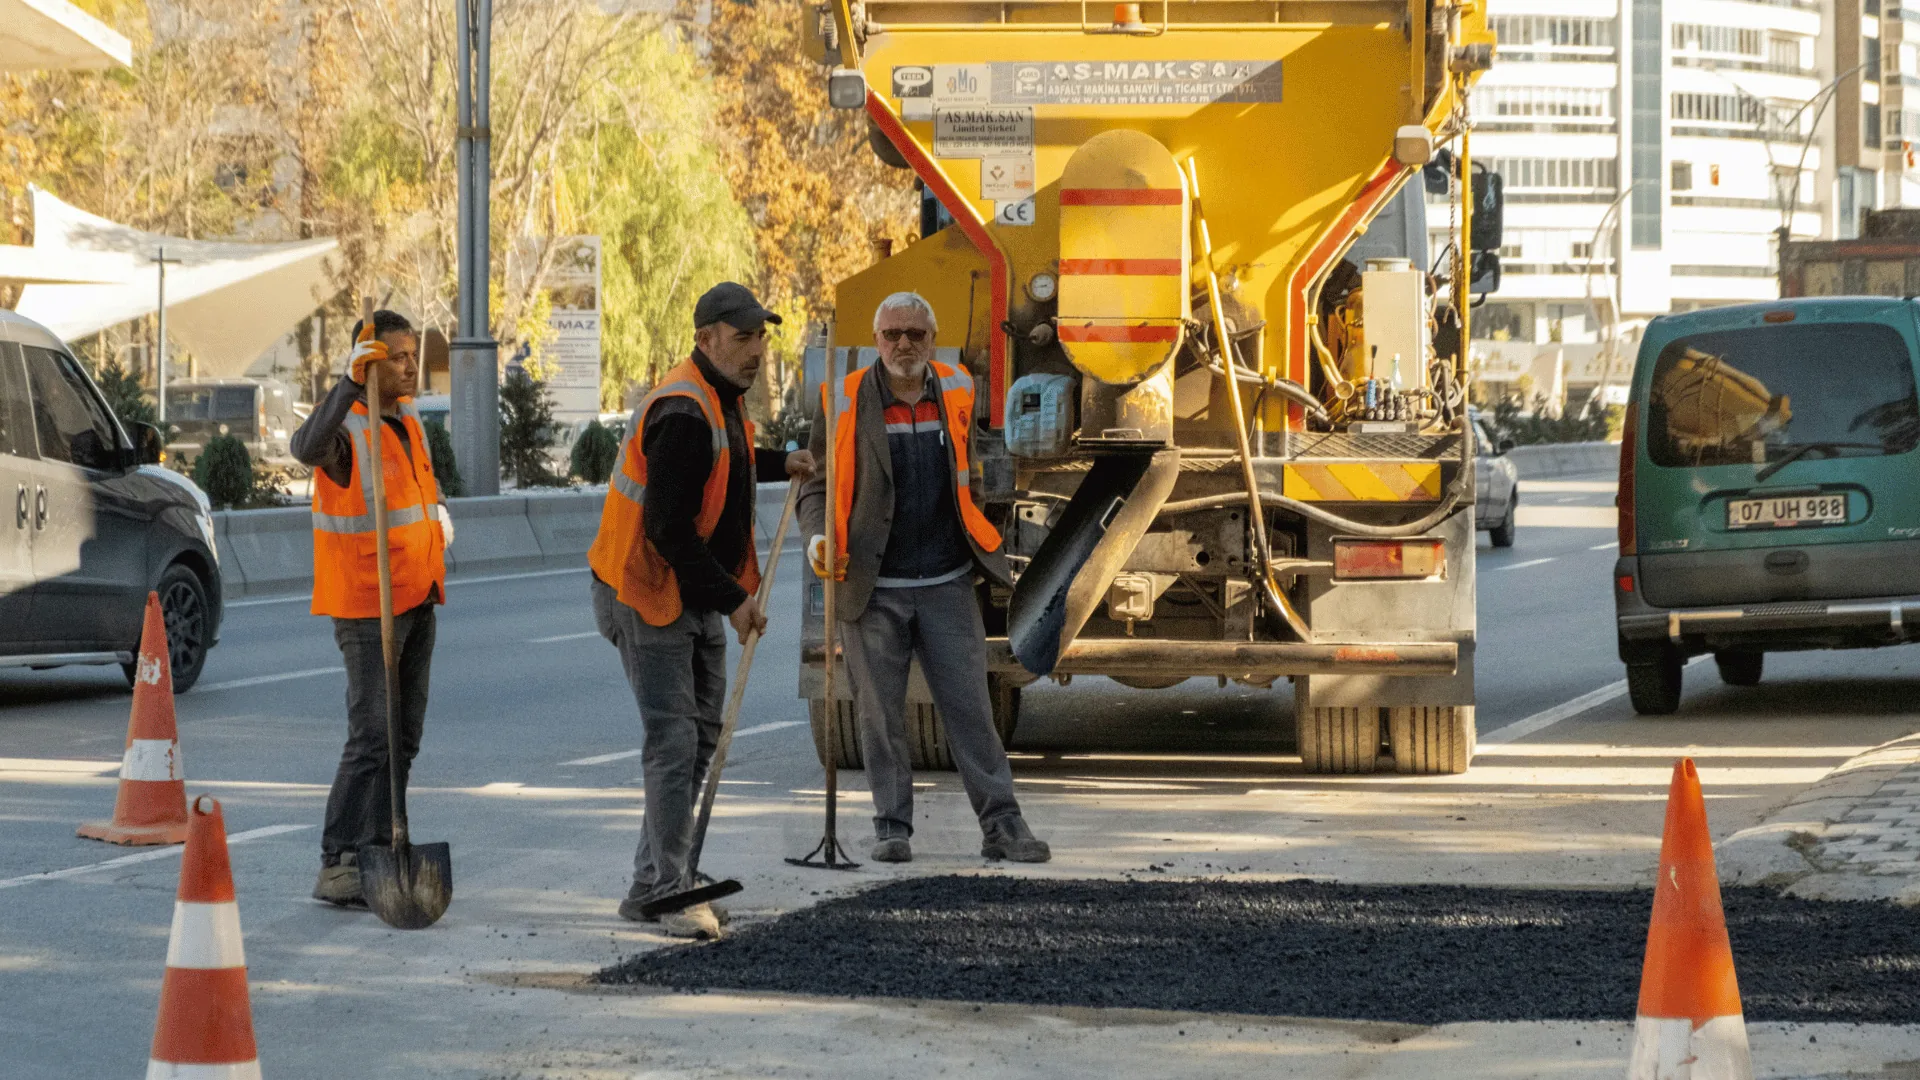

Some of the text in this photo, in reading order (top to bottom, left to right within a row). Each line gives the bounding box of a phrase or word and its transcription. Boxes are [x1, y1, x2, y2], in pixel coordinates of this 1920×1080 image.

[1048, 84, 1081, 95] ASFALT
[1162, 85, 1173, 94] ve
[944, 110, 1024, 124] AS.MAK.SAN
[953, 124, 985, 133] Limited
[1003, 203, 1028, 222] CE
[1741, 499, 1841, 521] 07 UH 988
